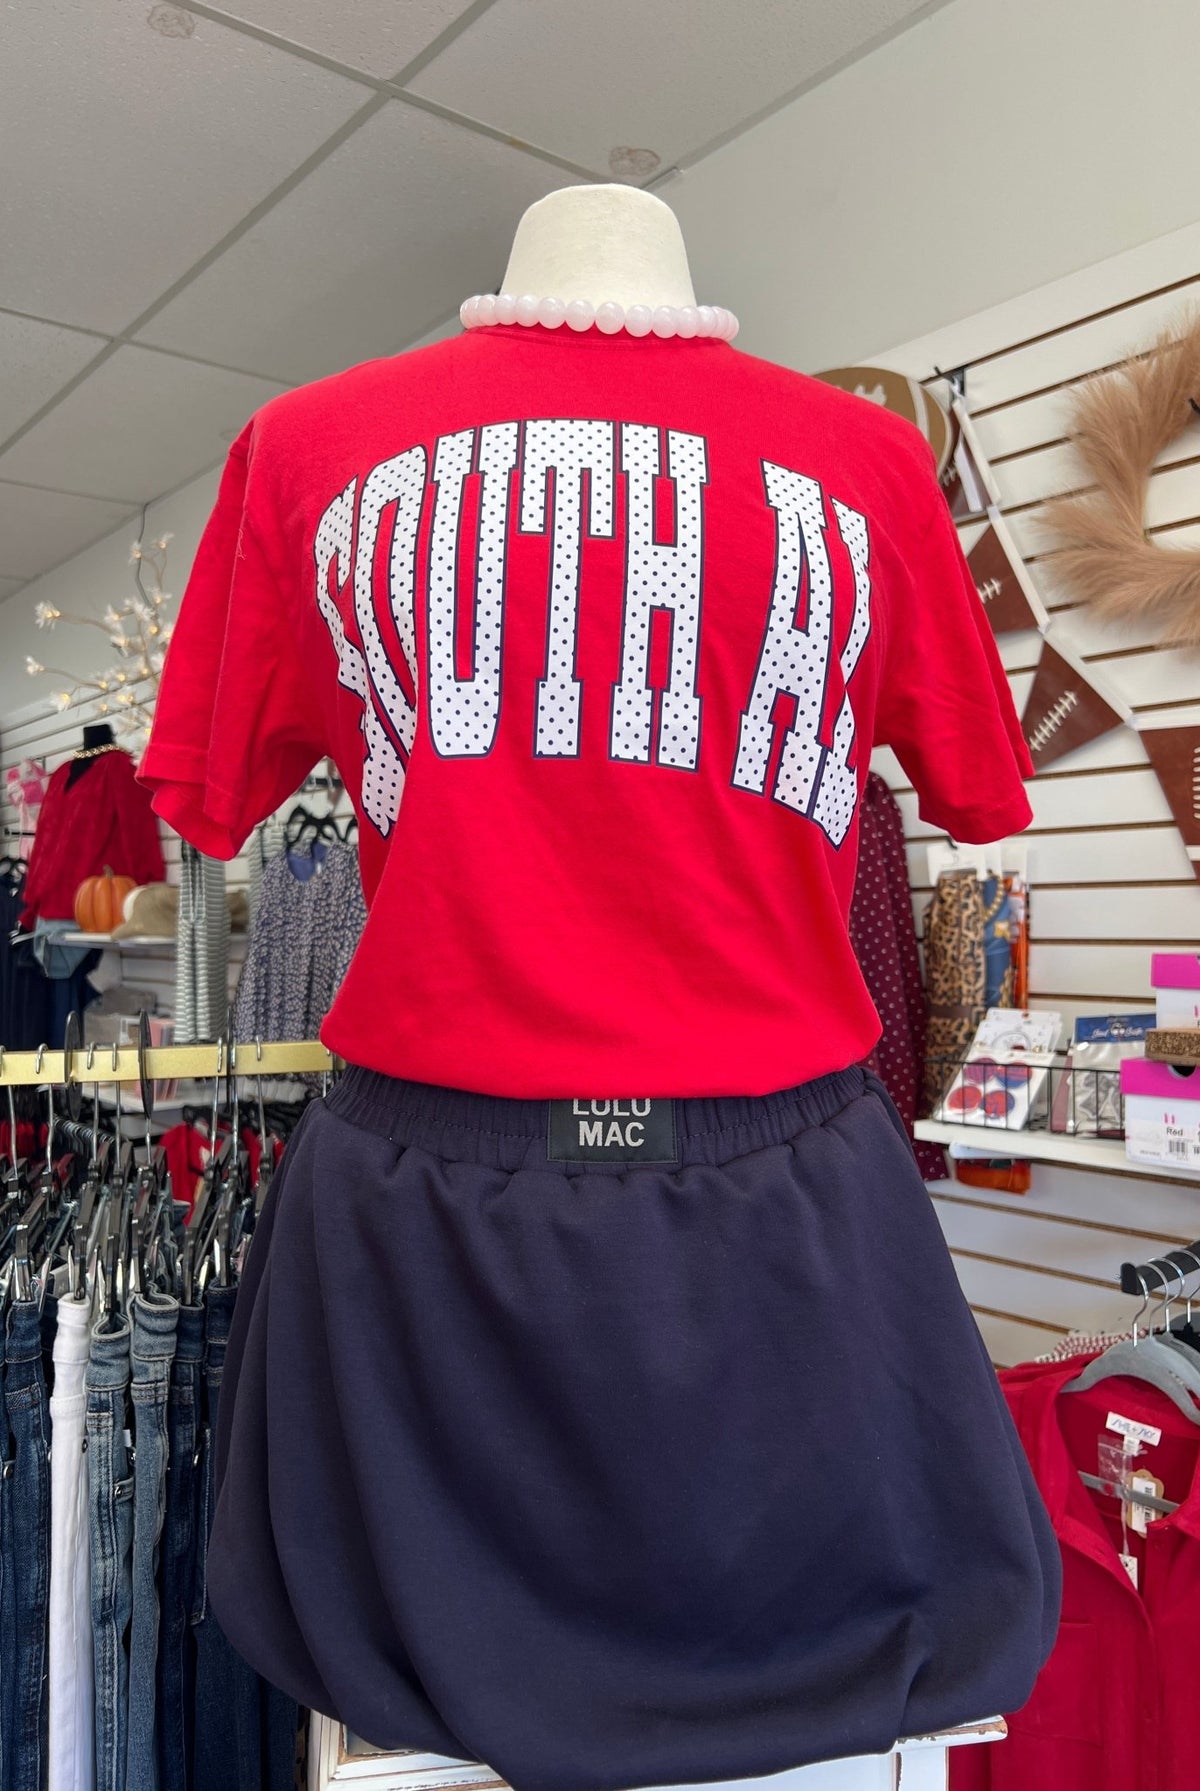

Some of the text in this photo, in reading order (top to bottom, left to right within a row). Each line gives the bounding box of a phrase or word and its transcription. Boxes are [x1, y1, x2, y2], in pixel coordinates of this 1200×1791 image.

[313, 418, 710, 840] SOUTH
[572, 1098, 651, 1117] LULU
[578, 1120, 645, 1148] MAC
